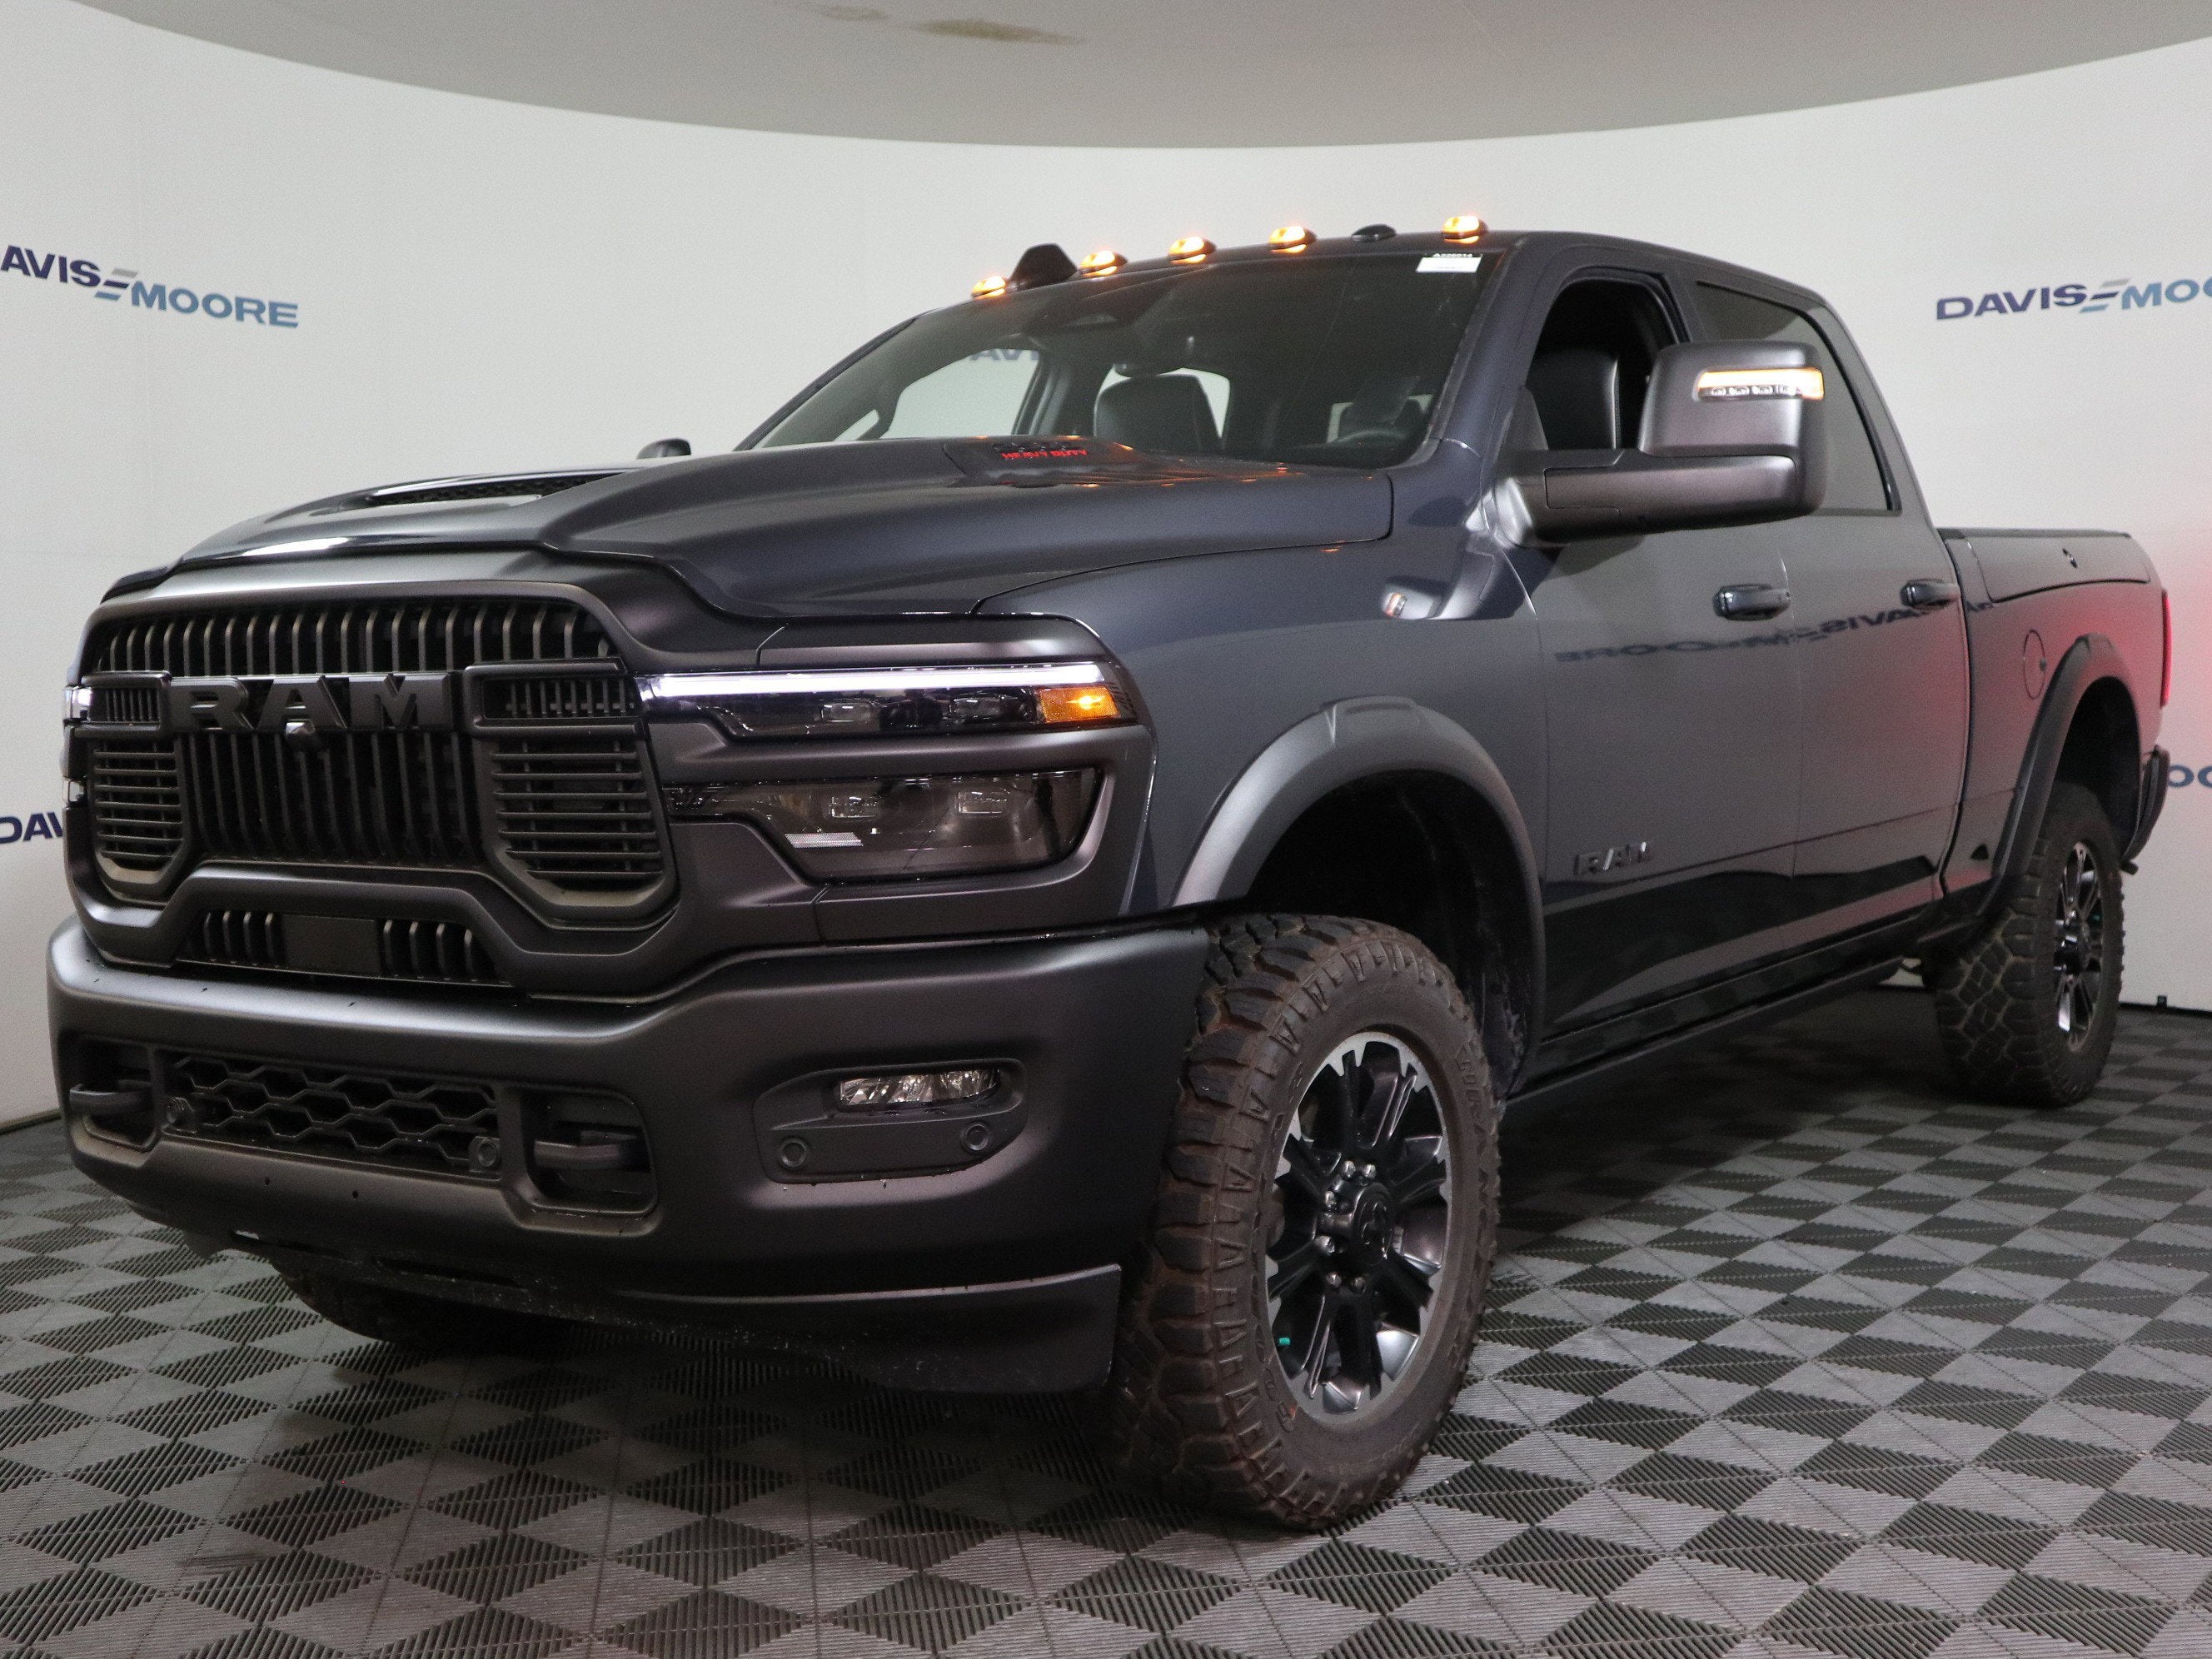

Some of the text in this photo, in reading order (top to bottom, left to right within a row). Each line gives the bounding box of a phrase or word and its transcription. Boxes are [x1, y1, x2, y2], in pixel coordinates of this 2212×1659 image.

[130, 280, 299, 328] MOORE
[1936, 276, 2212, 320] DAVIS MO
[169, 672, 451, 731] RAM
